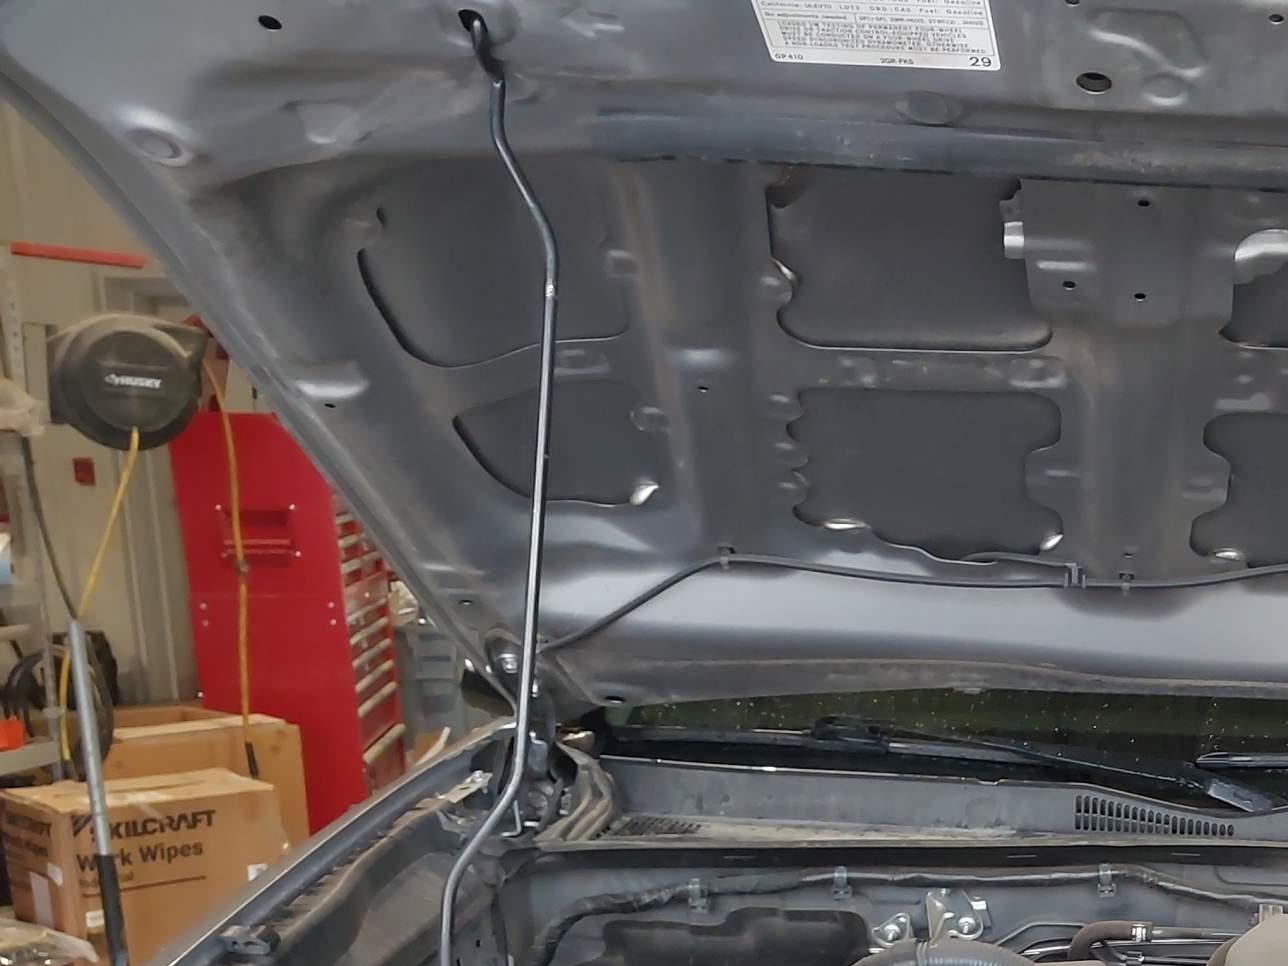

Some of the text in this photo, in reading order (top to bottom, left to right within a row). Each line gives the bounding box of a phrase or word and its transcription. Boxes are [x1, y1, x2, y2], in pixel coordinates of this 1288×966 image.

[968, 56, 992, 67] 29
[90, 809, 216, 843] KILCRAFT
[139, 842, 204, 865] Wipes
